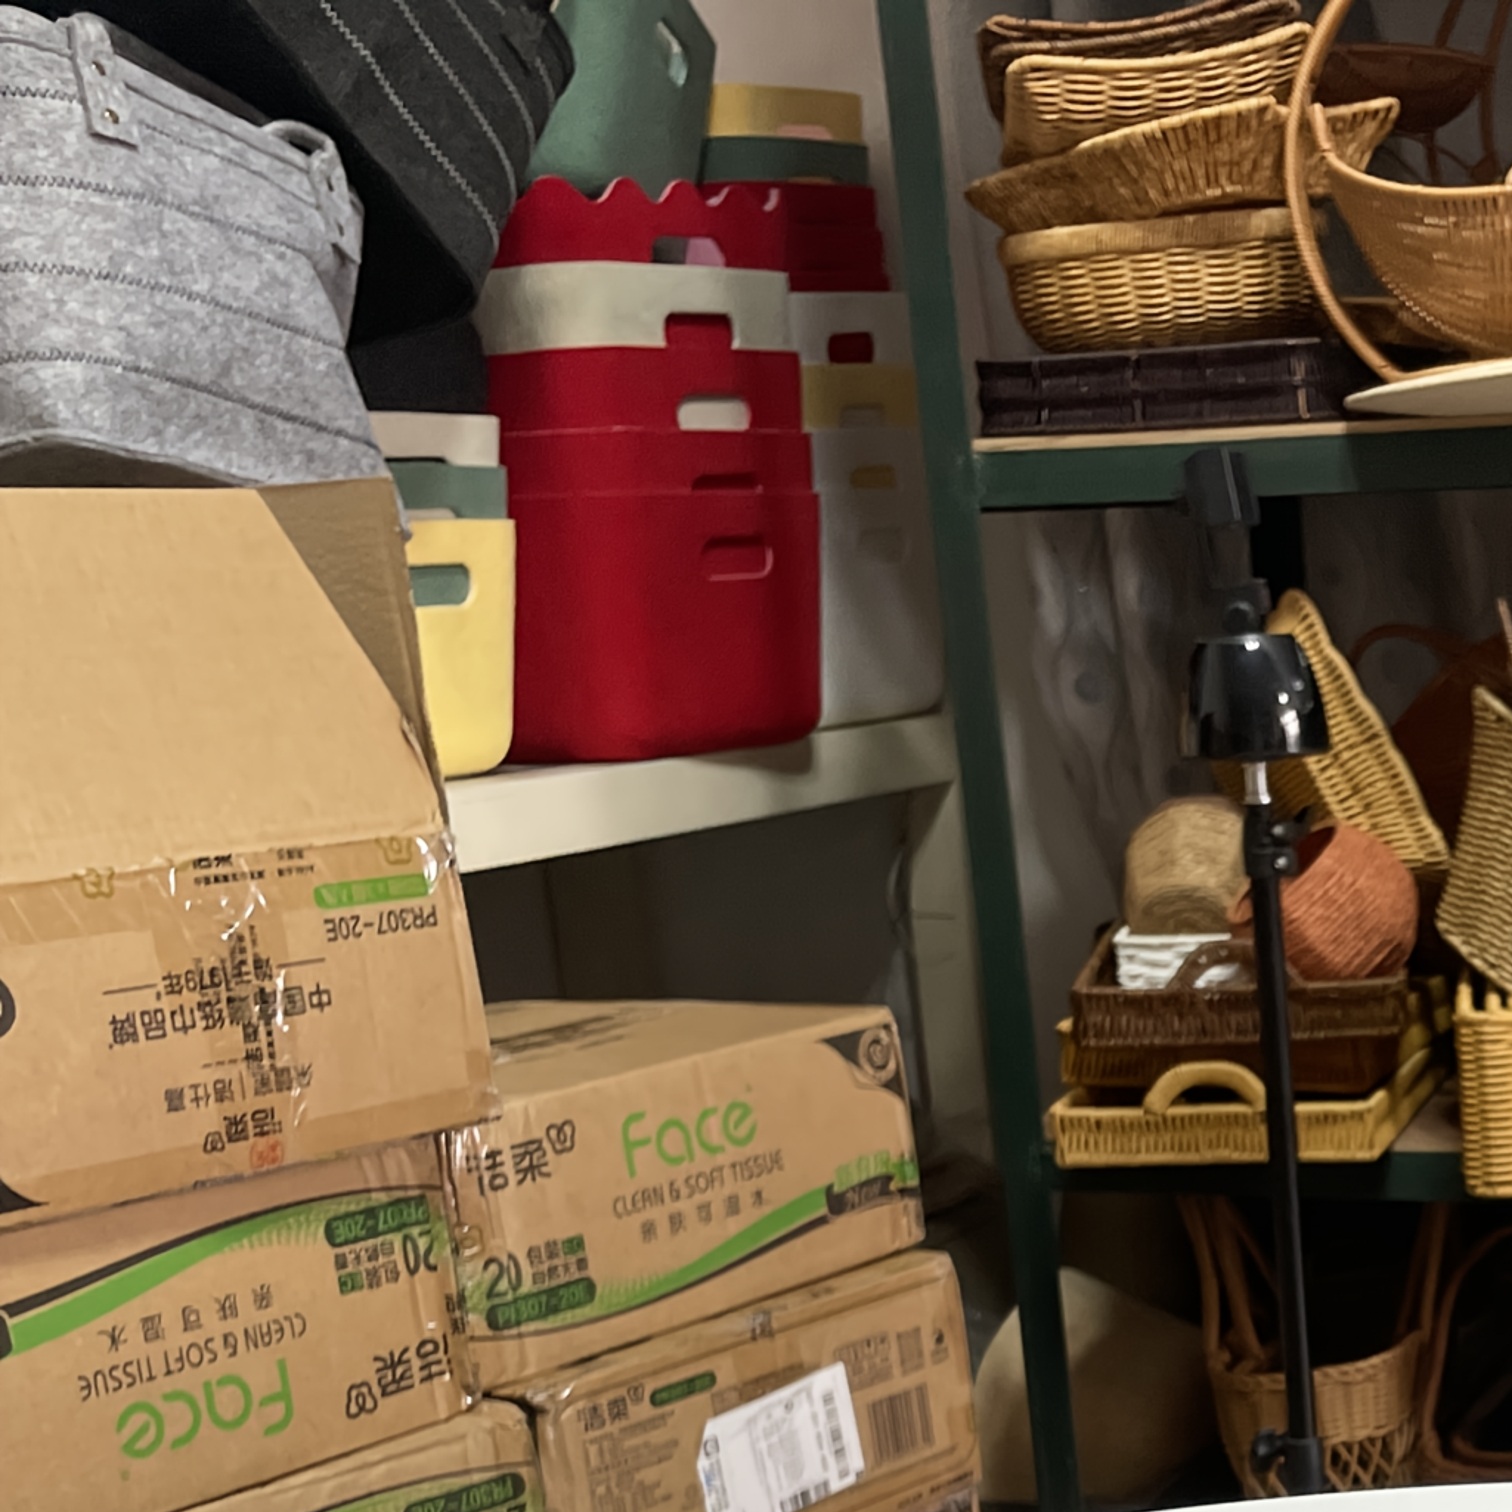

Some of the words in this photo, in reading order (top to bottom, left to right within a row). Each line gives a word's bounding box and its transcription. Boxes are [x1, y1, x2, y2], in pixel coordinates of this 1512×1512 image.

[324, 905, 438, 942] PR307-20E
[621, 1098, 759, 1179] Face
[466, 1136, 551, 1197] 洁柔
[613, 1183, 664, 1218] CLEAN
[669, 1180, 681, 1203] &
[684, 1165, 725, 1198] SOFT
[731, 1148, 785, 1184] TISSUE
[402, 1232, 437, 1277] 20
[483, 1252, 522, 1301] 20
[223, 1338, 238, 1358] &
[245, 1312, 306, 1351] CLEAN
[79, 1360, 156, 1401] TISSUE
[163, 1339, 217, 1375] SOFT
[374, 1337, 451, 1398] 洁柔
[116, 1358, 294, 1459] Face
